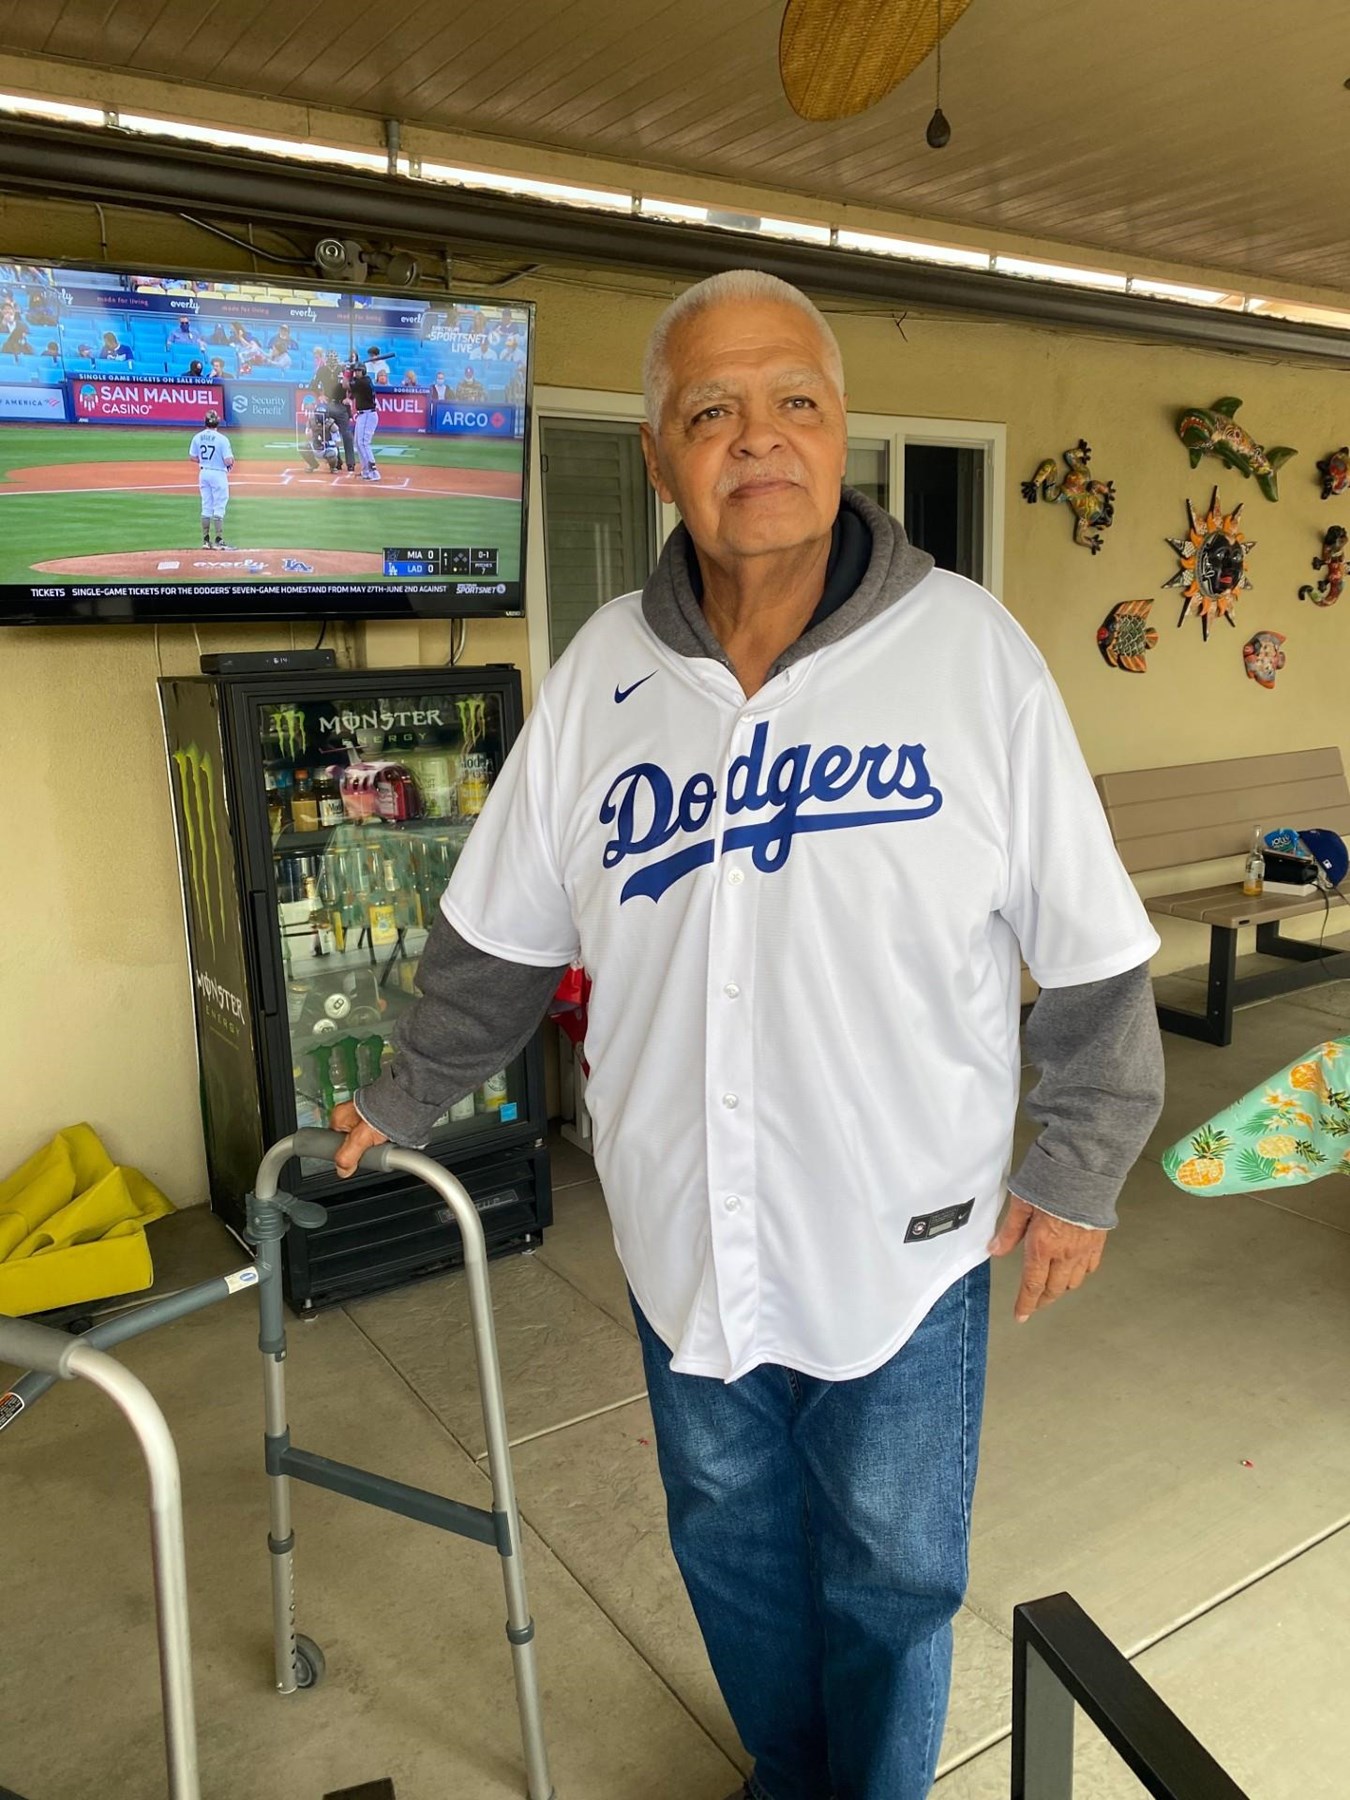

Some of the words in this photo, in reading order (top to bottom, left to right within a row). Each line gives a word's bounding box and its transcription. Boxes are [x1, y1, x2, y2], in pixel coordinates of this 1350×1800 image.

[170, 298, 200, 314] everly
[290, 307, 317, 323] everly
[400, 314, 421, 324] everl
[430, 331, 488, 344] SPORTSNET
[451, 342, 473, 353] LIVE
[79, 373, 106, 381] SINGLE
[108, 374, 130, 382] GAME
[132, 375, 161, 383] TICKETS
[100, 386, 139, 402] SAN
[143, 387, 219, 405] MANUEL
[251, 396, 286, 407] Security
[5, 399, 43, 407] AMERICA
[101, 402, 150, 415] CASINO
[252, 404, 282, 415] Benefit
[375, 397, 424, 413] ANUEL
[441, 411, 488, 427] ARCO
[200, 444, 216, 461] 27
[407, 550, 423, 560] MIA
[427, 550, 434, 560] 0
[193, 559, 268, 570] everly
[407, 565, 423, 573] LAD
[427, 565, 434, 574] 0
[30, 588, 66, 597] TICKETS
[71, 587, 128, 596] SINGLE-GAME
[128, 587, 160, 596] TICKETS
[160, 587, 177, 595] FOR
[177, 586, 193, 595] THE
[193, 586, 231, 595] DODGERS'
[232, 586, 280, 594] SEVEN-GAME
[281, 585, 327, 594] HOMESTAND
[328, 585, 349, 593] FROM
[350, 585, 366, 593] MAY
[367, 585, 404, 593] 27TH-JUNE
[404, 585, 418, 593] 2ND
[419, 585, 447, 593] AGAINST
[455, 585, 497, 594] SPORTSNET
[318, 709, 445, 735] MONSTER
[599, 721, 943, 904] Dodgers
[195, 970, 245, 1026] MONSTER
[205, 1004, 240, 1036] ENERGY
